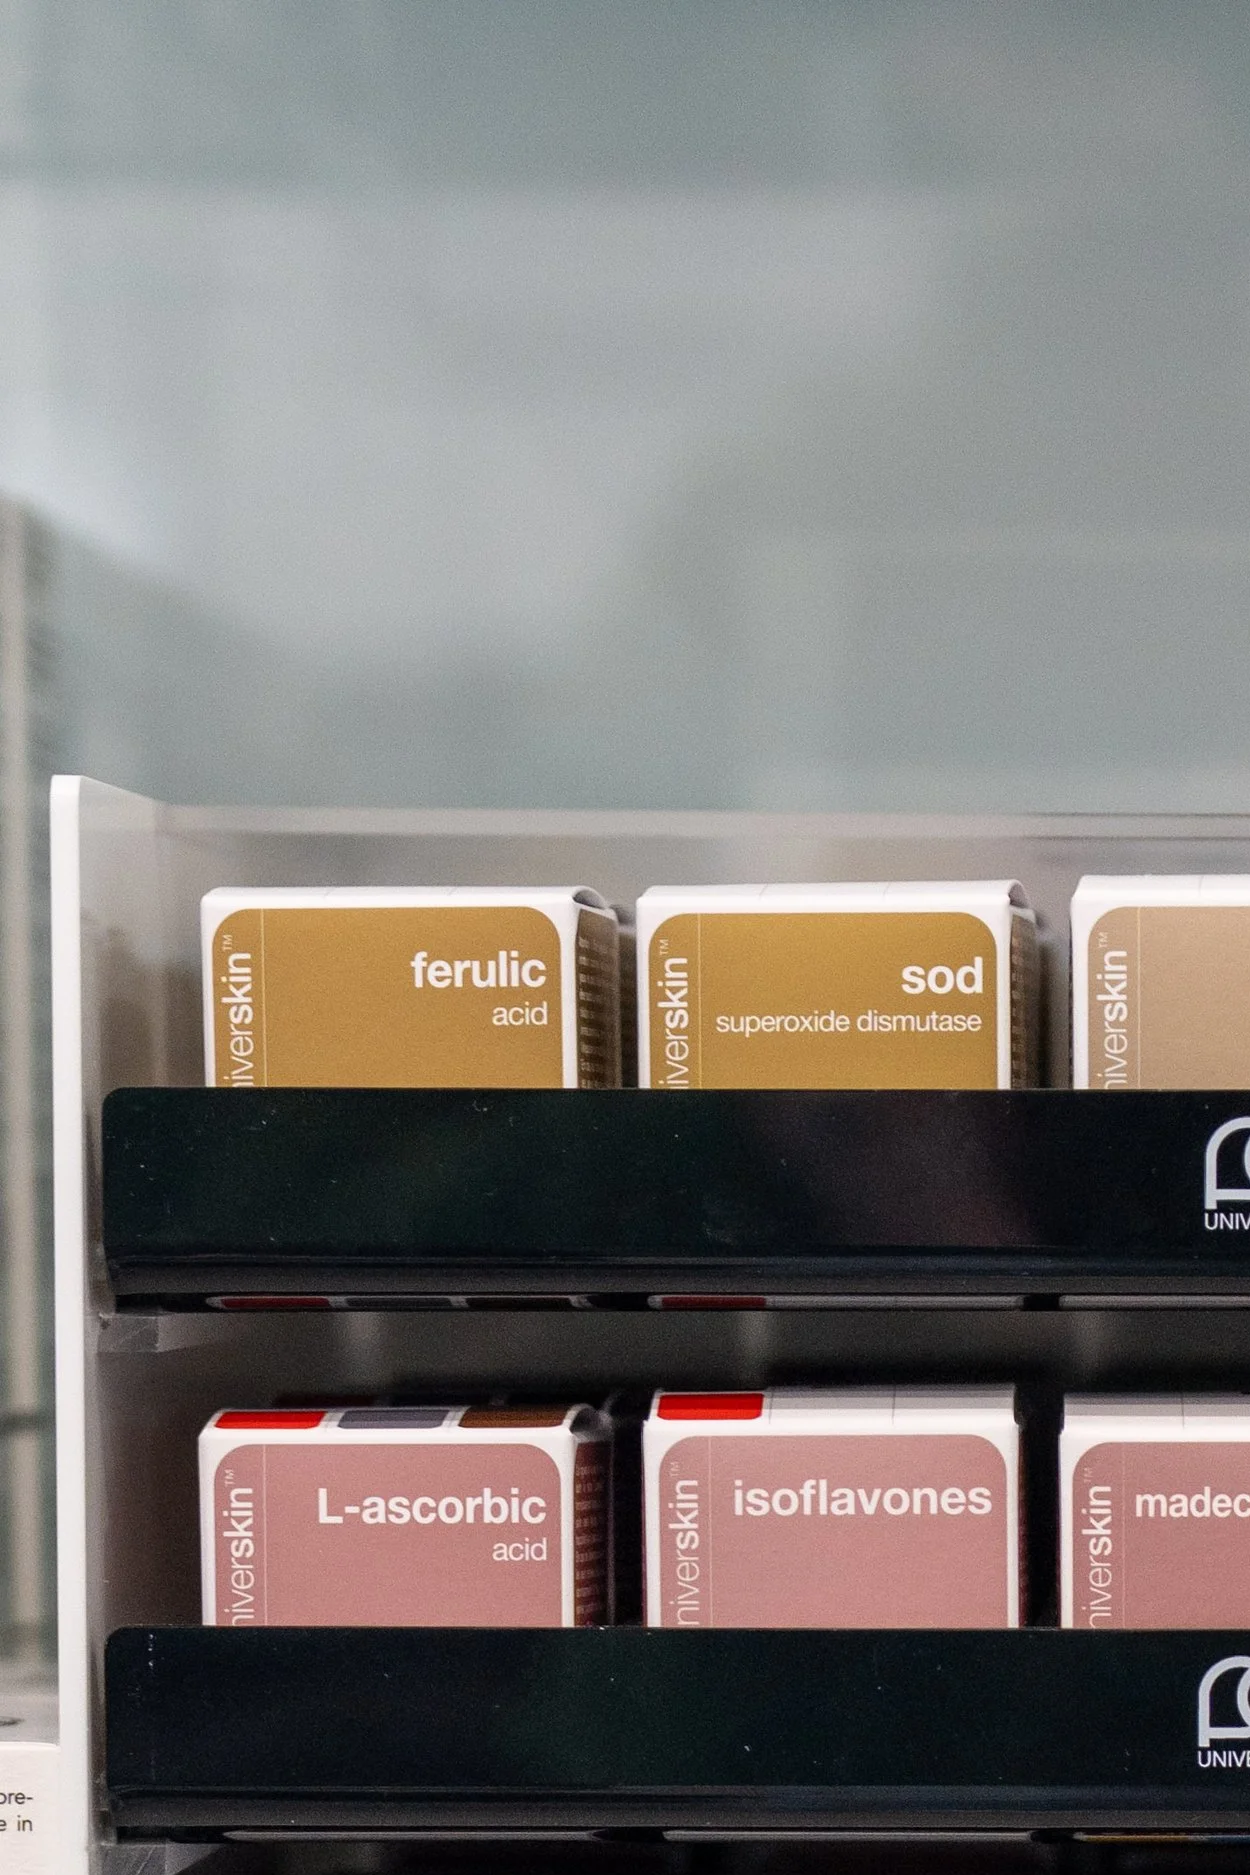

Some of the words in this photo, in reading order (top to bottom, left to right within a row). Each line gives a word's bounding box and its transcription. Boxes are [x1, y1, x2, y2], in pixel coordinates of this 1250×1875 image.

[410, 950, 546, 988] ferulic
[901, 956, 984, 995] sod
[492, 1001, 548, 1026] acid
[716, 1009, 850, 1037] superoxide
[856, 1010, 981, 1032] dismutase
[318, 1487, 547, 1524] L-ascorbic
[734, 1479, 992, 1516] isoflavones
[492, 1537, 547, 1561] acid
